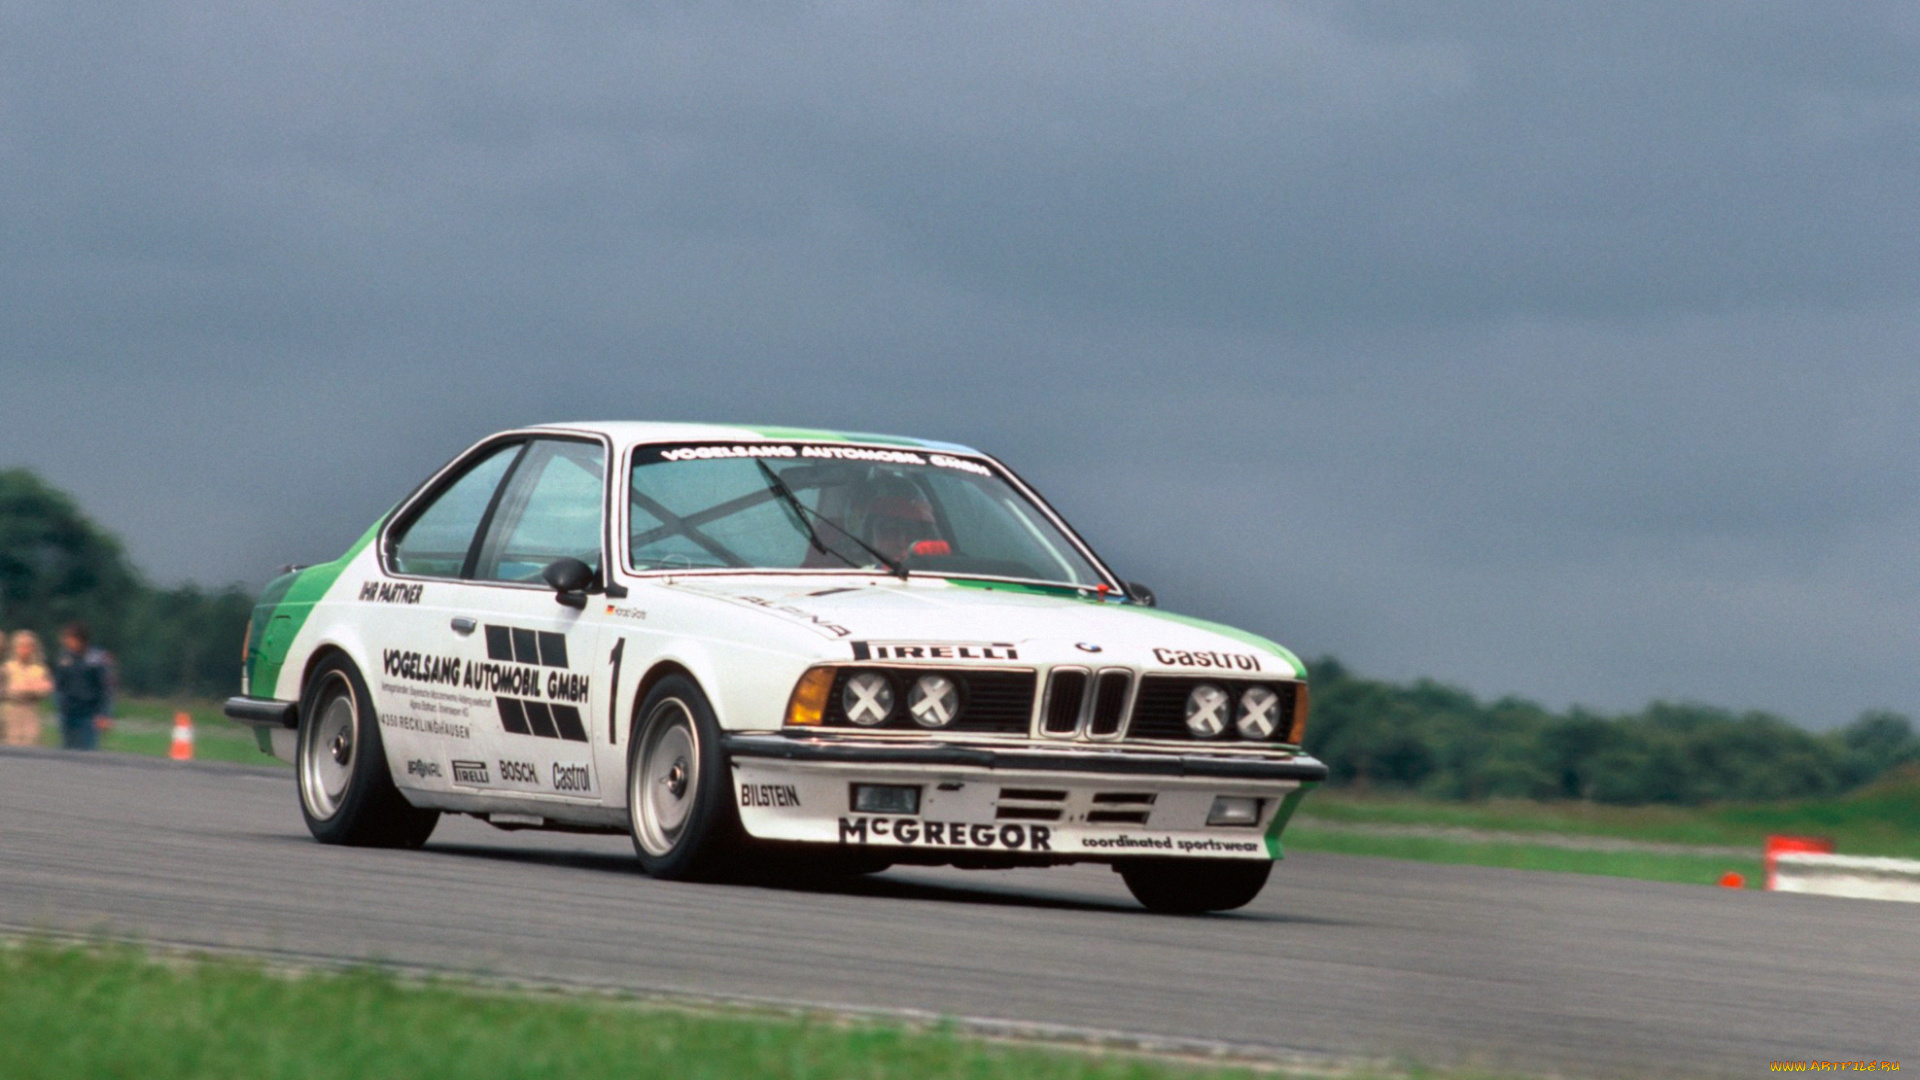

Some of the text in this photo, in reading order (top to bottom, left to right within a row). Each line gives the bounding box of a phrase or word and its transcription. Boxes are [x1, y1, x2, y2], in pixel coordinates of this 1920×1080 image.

[661, 445, 797, 461] VOGELSANG
[801, 446, 926, 465] AUTOMOBIL
[359, 580, 423, 604] IHR PARTNER
[850, 641, 1018, 661] PIRELLI
[1152, 648, 1261, 671] Castrol
[383, 648, 461, 687] VOGELSANG
[463, 660, 541, 697] AUTOMOBIL
[547, 671, 589, 704] GMBH
[608, 637, 626, 745] 1
[399, 715, 470, 739] RECKLINGHAUSEN
[452, 760, 489, 783] PIRELLI
[499, 760, 539, 784] BOSCH
[552, 762, 590, 791] Castrol
[741, 784, 800, 806] BILSTEIN
[1082, 835, 1258, 852] coordinated sportswear
